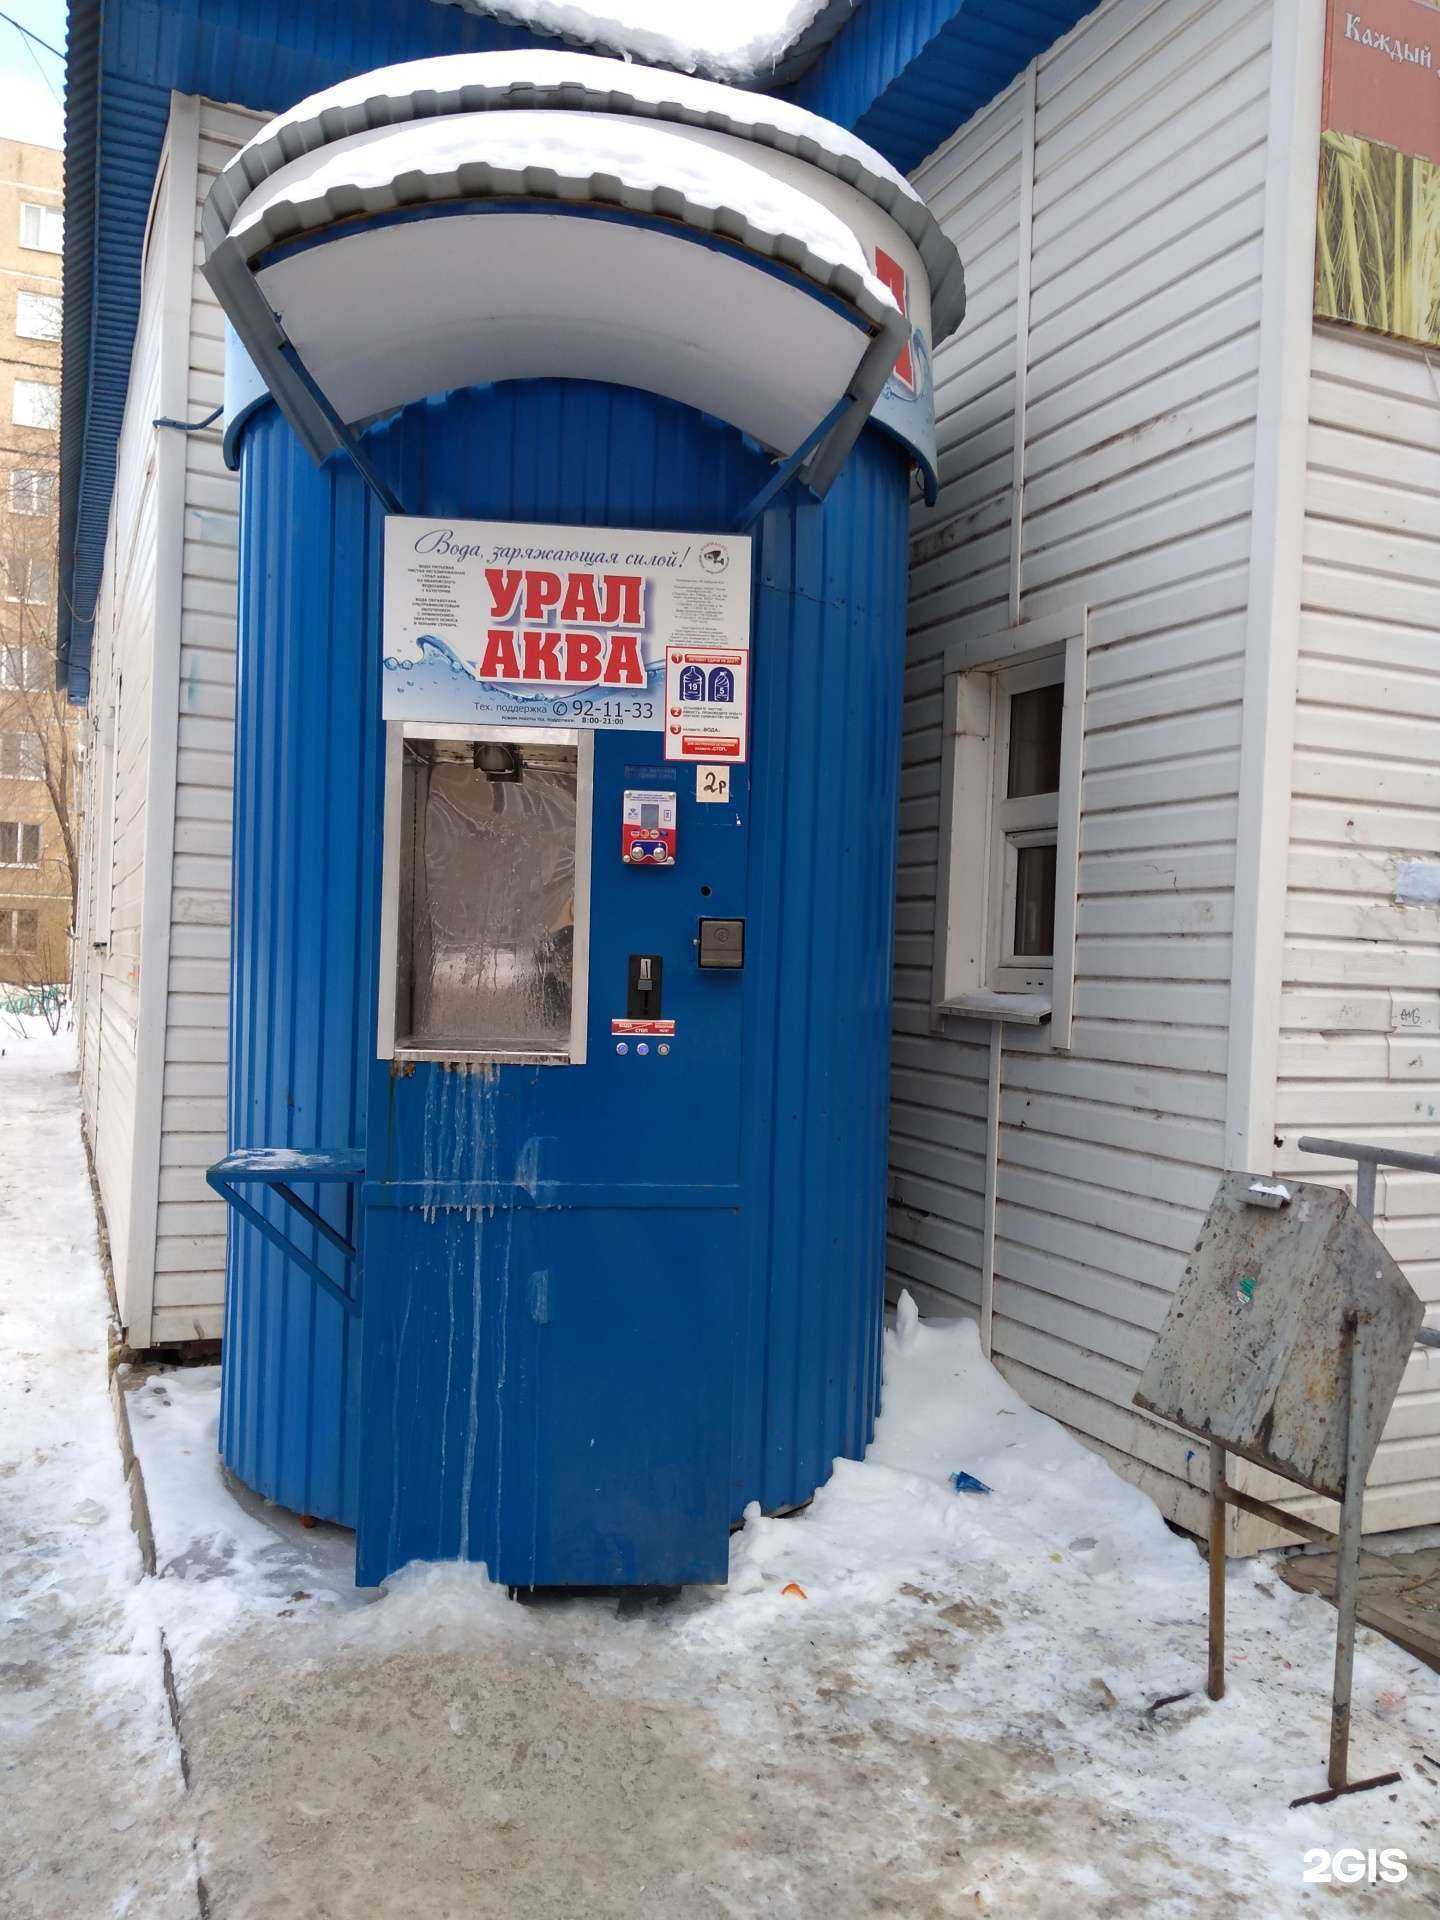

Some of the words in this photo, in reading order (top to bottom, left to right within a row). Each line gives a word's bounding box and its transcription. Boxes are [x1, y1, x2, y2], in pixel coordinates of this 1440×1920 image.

[1344, 12, 1432, 69] Каждый
[414, 529, 484, 562] Вода,
[486, 543, 618, 567] заряжающая
[625, 546, 692, 568] силой!
[484, 568, 643, 625] УРАЛ
[478, 629, 645, 686] АКВА
[687, 682, 699, 691] 19
[474, 702, 493, 711] Тех.
[496, 704, 548, 715] поддержка
[572, 700, 654, 719] 92-11-33
[582, 717, 624, 725] 8:00-21:00
